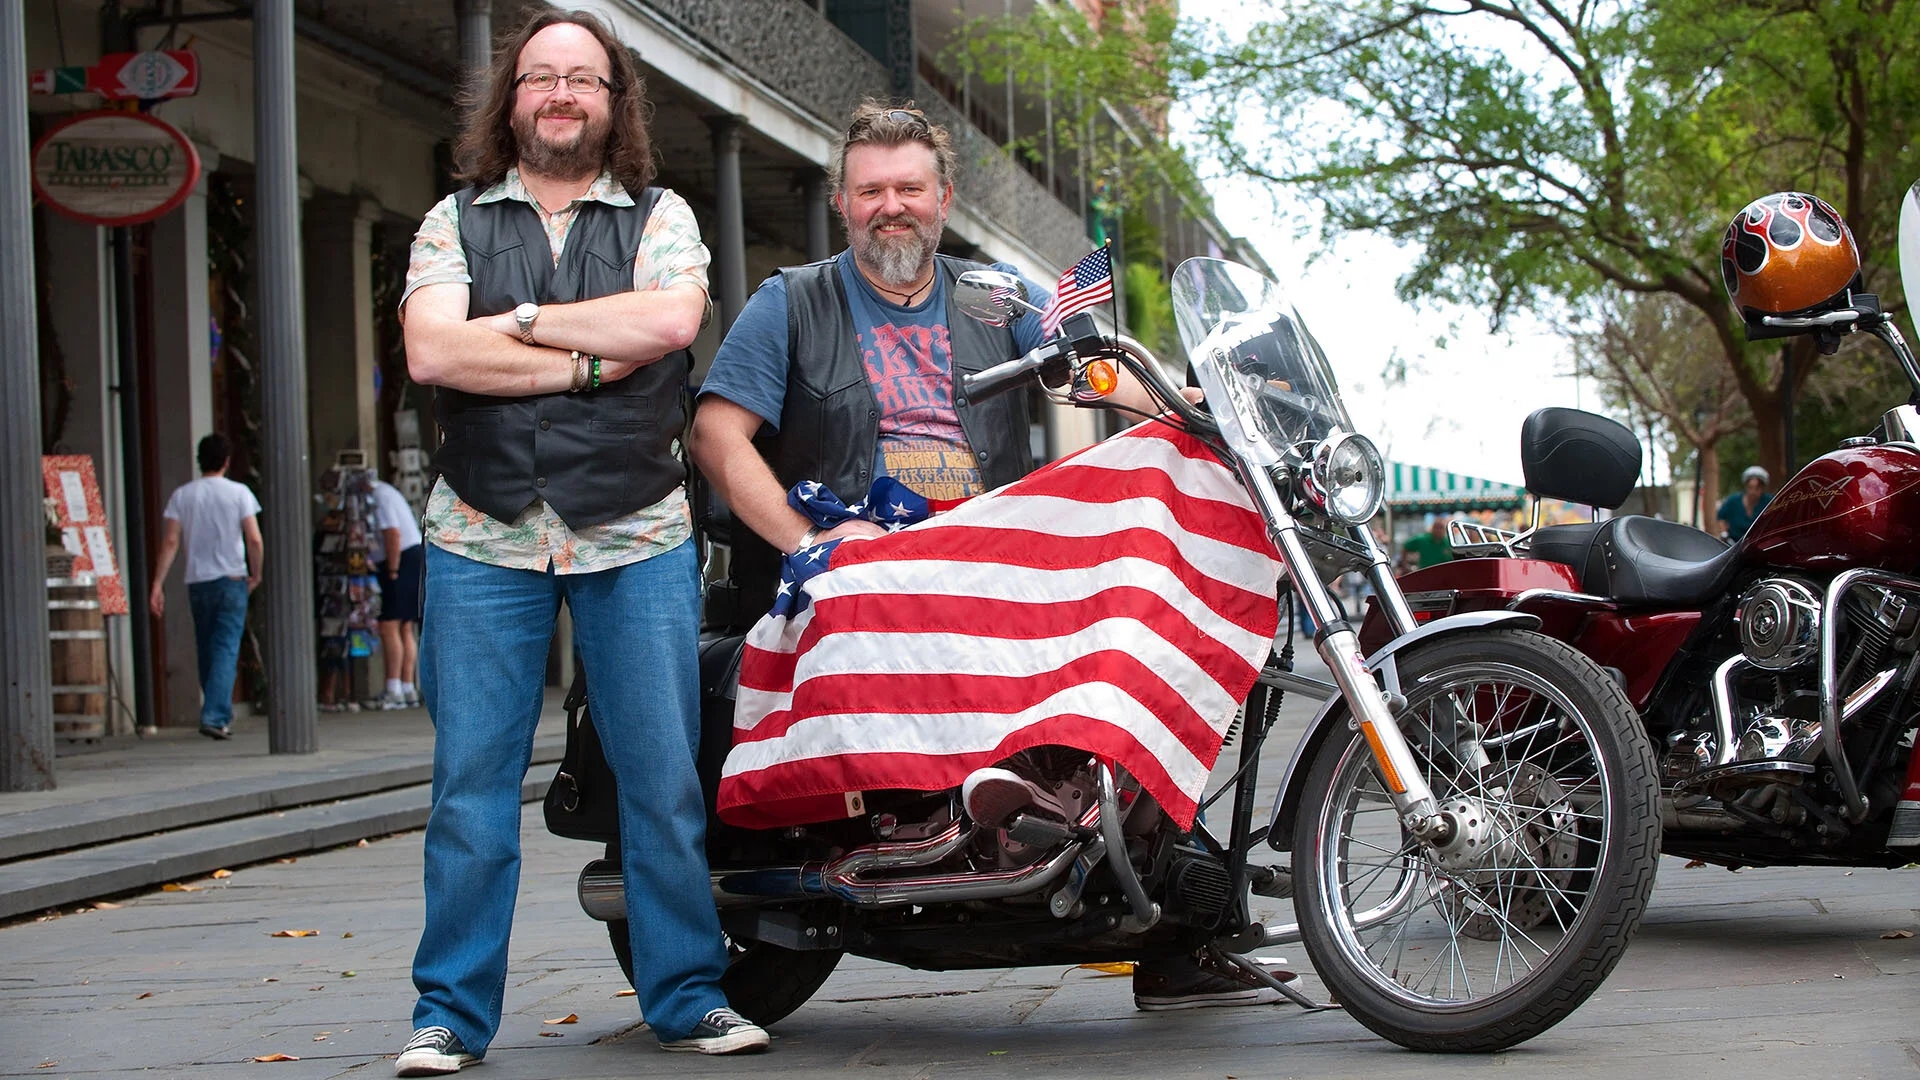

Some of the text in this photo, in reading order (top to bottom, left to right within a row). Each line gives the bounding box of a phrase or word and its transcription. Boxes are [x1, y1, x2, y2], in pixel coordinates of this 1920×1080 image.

[48, 141, 172, 172] TABASCO
[884, 451, 943, 469] INDIANA
[887, 468, 974, 484] PORTLAND
